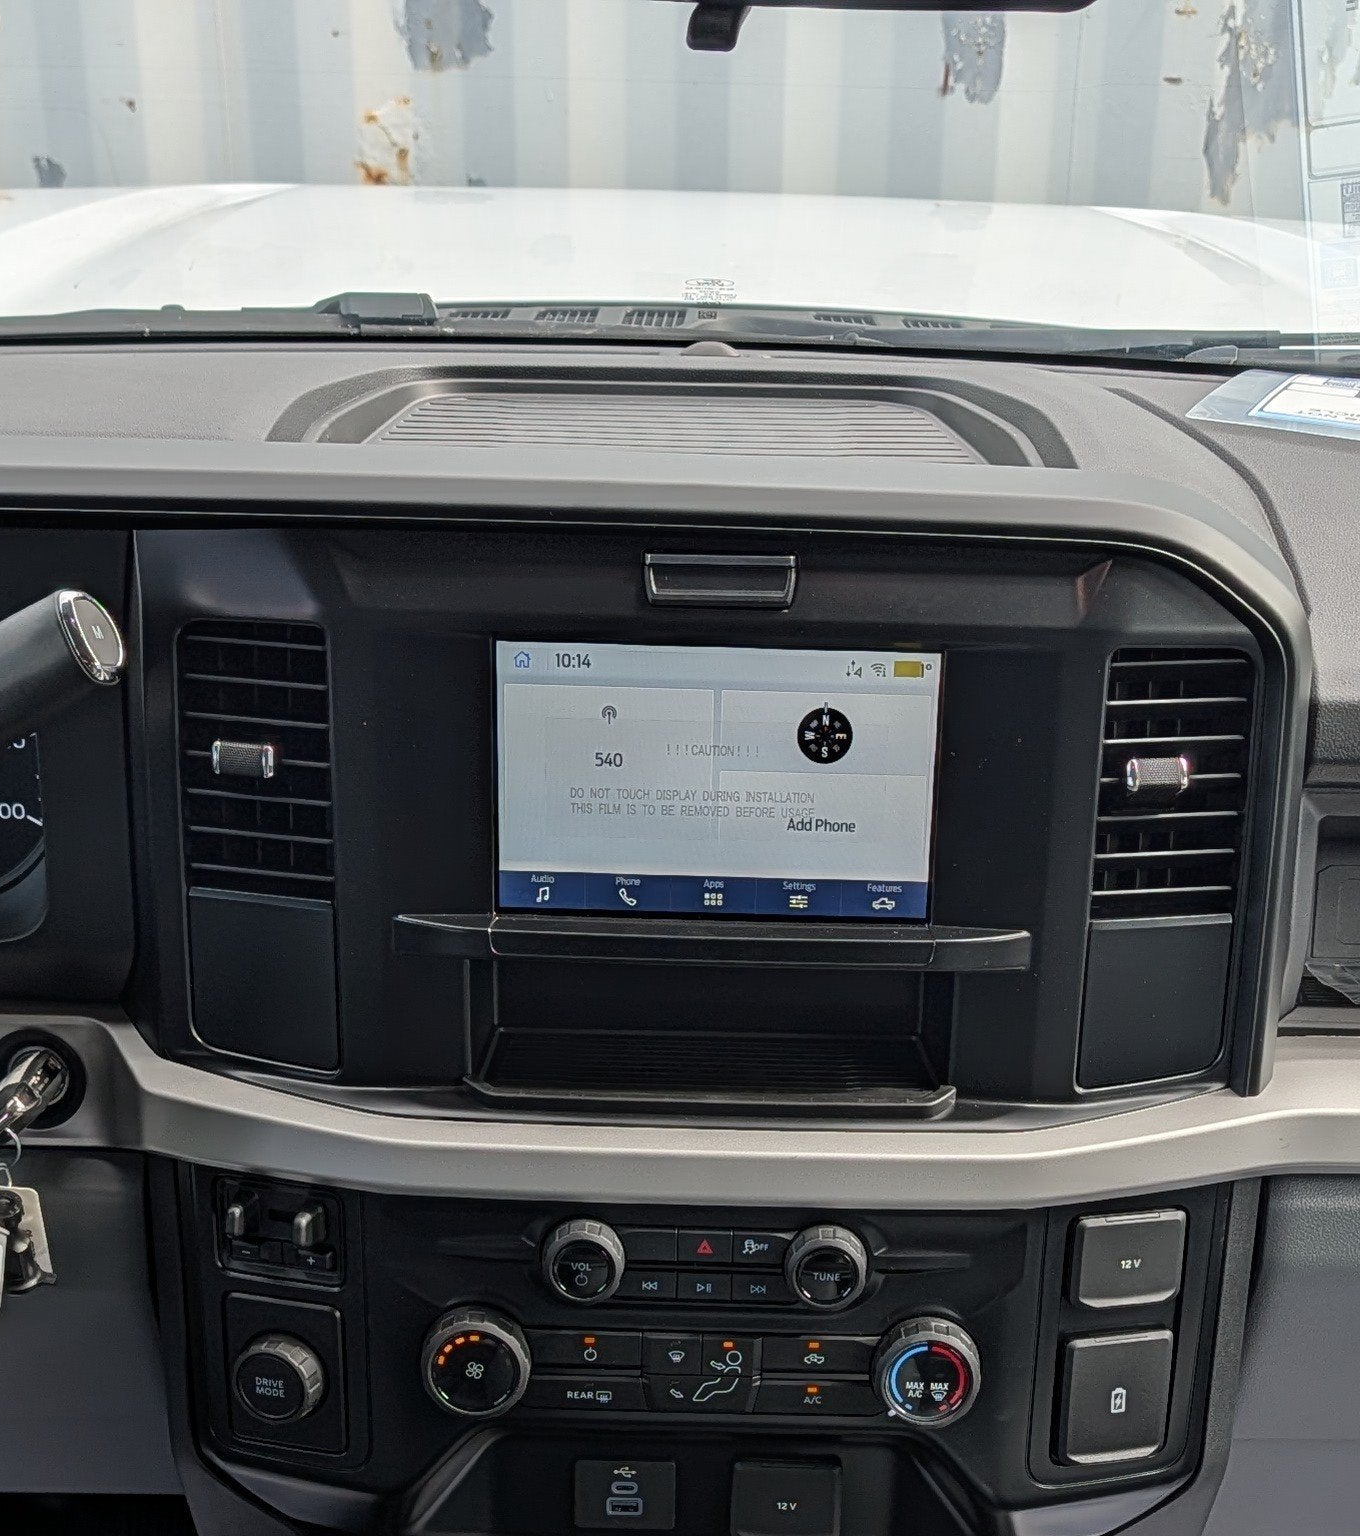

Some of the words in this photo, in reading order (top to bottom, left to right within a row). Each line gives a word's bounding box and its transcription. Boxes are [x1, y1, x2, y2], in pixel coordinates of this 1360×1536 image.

[555, 652, 592, 671] 10:14
[822, 714, 830, 726] N
[821, 746, 829, 758] S
[594, 752, 624, 768] 540
[570, 787, 584, 800] DO
[590, 788, 610, 800] NOT
[616, 788, 650, 801] TOUCH
[656, 789, 697, 802] DISPLAY
[702, 790, 741, 804] DURING
[745, 791, 815, 805] INSTALLATION
[570, 802, 592, 815] THIS
[599, 803, 621, 816] FILM
[627, 804, 637, 816] IS
[642, 804, 656, 817] TO
[660, 804, 675, 817] BE
[680, 805, 730, 818] REMOVED
[736, 805, 776, 819] BEFORE
[786, 817, 811, 834] Add
[814, 818, 856, 834] Phone
[531, 874, 555, 885] Audio
[615, 876, 640, 887] Phone
[703, 879, 724, 891] Apps
[782, 881, 817, 893] Settings
[866, 883, 902, 895] Features
[754, 1243, 769, 1251] OFF
[571, 1262, 592, 1271] VOL
[1121, 1259, 1132, 1269] 12
[1133, 1259, 1141, 1269] V
[813, 1272, 841, 1282] TUNE
[255, 1376, 285, 1389] DRIVE
[905, 1382, 925, 1391] MAX
[930, 1382, 949, 1391] MAX
[255, 1385, 285, 1398] MODE
[566, 1391, 594, 1400] REAR
[907, 1389, 923, 1399] A/C
[803, 1395, 822, 1405] A/C
[776, 1502, 788, 1510] 12
[789, 1502, 797, 1510] V
